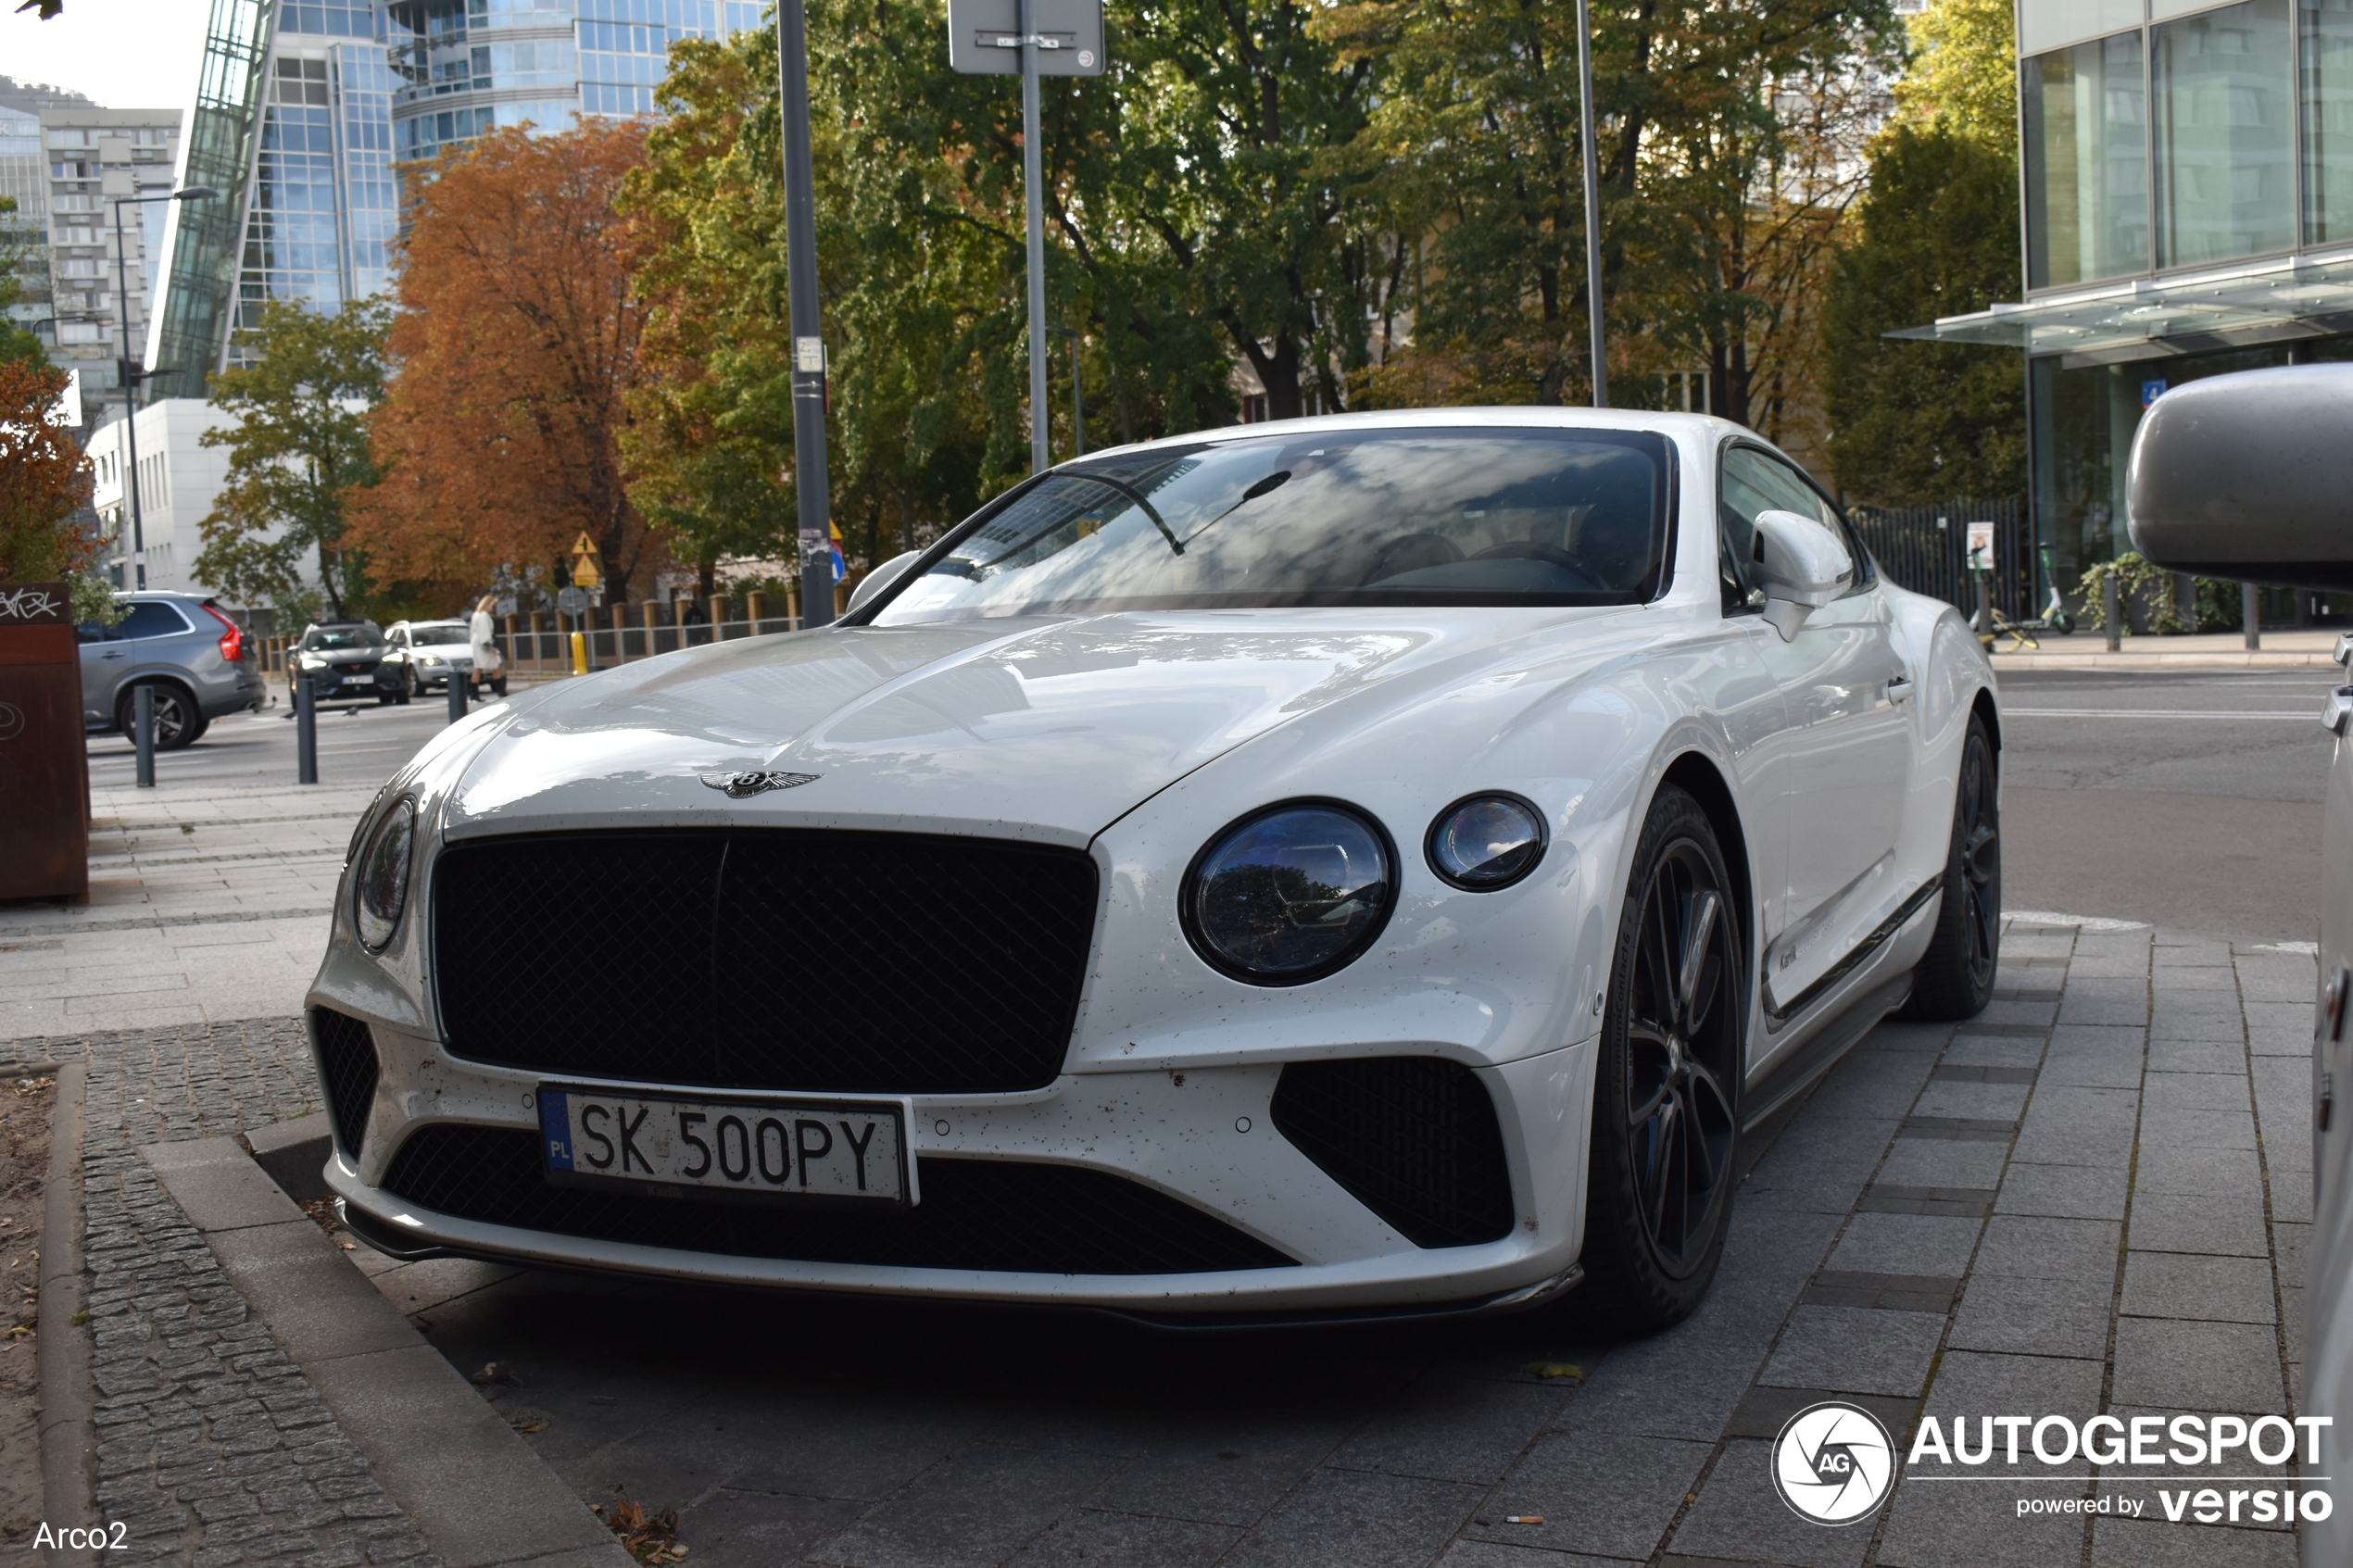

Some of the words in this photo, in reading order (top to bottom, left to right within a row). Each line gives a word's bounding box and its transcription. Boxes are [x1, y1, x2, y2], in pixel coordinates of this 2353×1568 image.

[1614, 947, 1629, 1096] PremiumContact
[1622, 931, 1630, 944] 6
[550, 1141, 570, 1159] PL
[581, 1104, 655, 1174] SK
[679, 1112, 876, 1190] 500PY
[647, 1185, 684, 1198] Karlik
